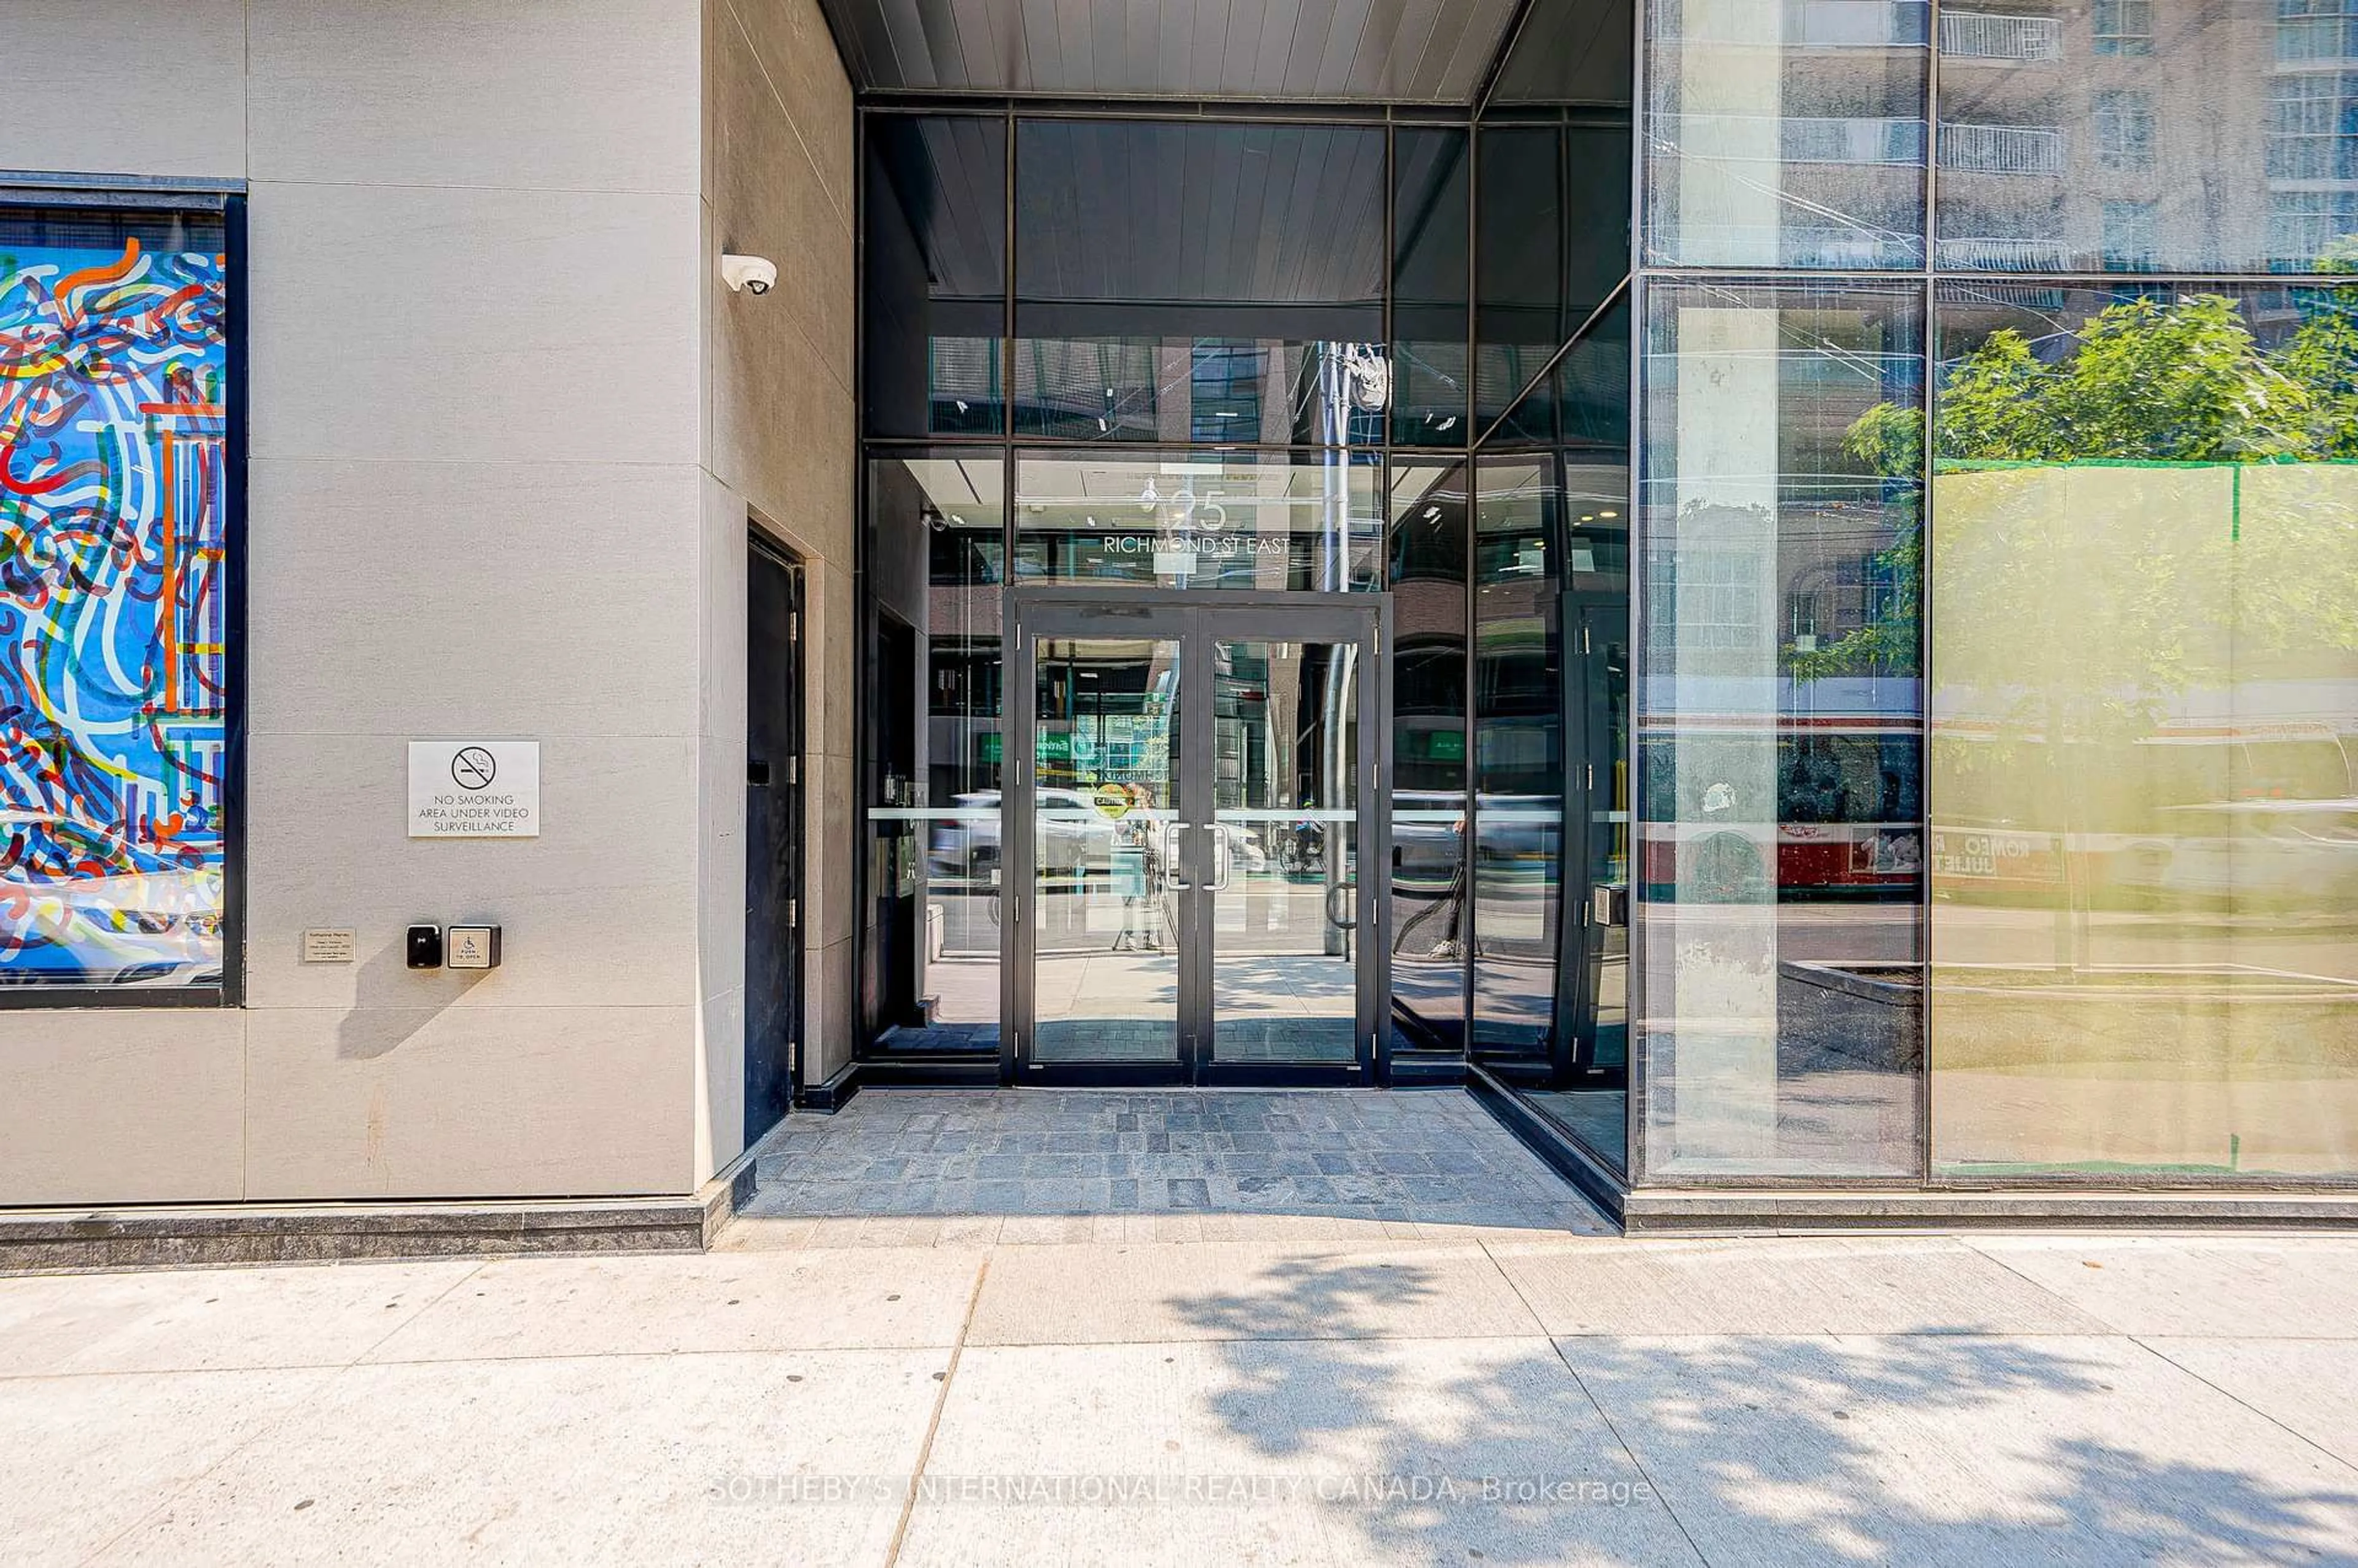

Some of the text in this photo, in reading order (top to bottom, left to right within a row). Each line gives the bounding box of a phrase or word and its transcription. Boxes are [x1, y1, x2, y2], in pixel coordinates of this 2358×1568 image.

[1171, 491, 1226, 530] 25
[1103, 536, 1291, 554] RICHMOND ST EAST
[434, 795, 514, 805] NO SMOKING
[419, 808, 529, 818] AREA UNDER VIDEO
[434, 821, 515, 831] SURVEILLANCE
